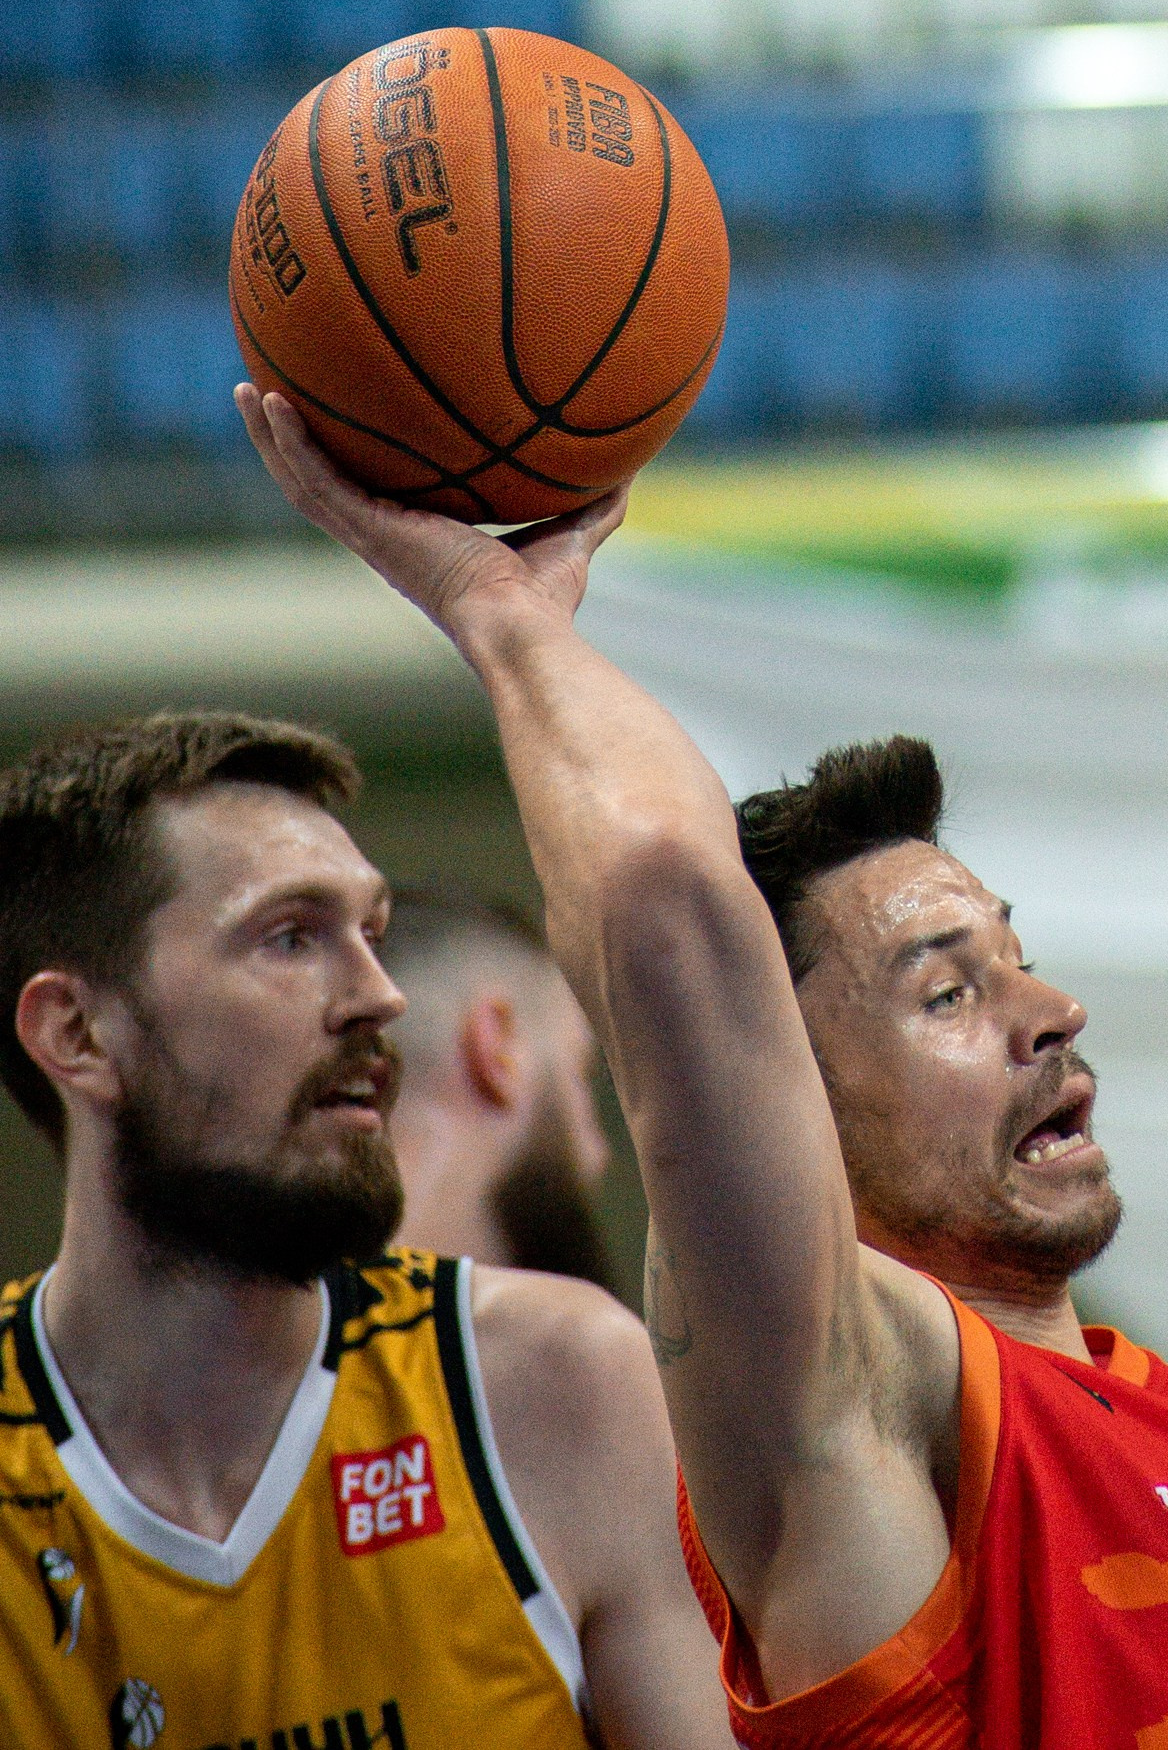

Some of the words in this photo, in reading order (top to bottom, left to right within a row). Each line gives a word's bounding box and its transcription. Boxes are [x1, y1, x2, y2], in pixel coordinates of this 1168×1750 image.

[560, 75, 586, 152] APPROVED
[585, 82, 635, 167] FIBA
[356, 172, 378, 222] BALL
[341, 1442, 425, 1502] FON
[347, 1482, 431, 1545] BET
